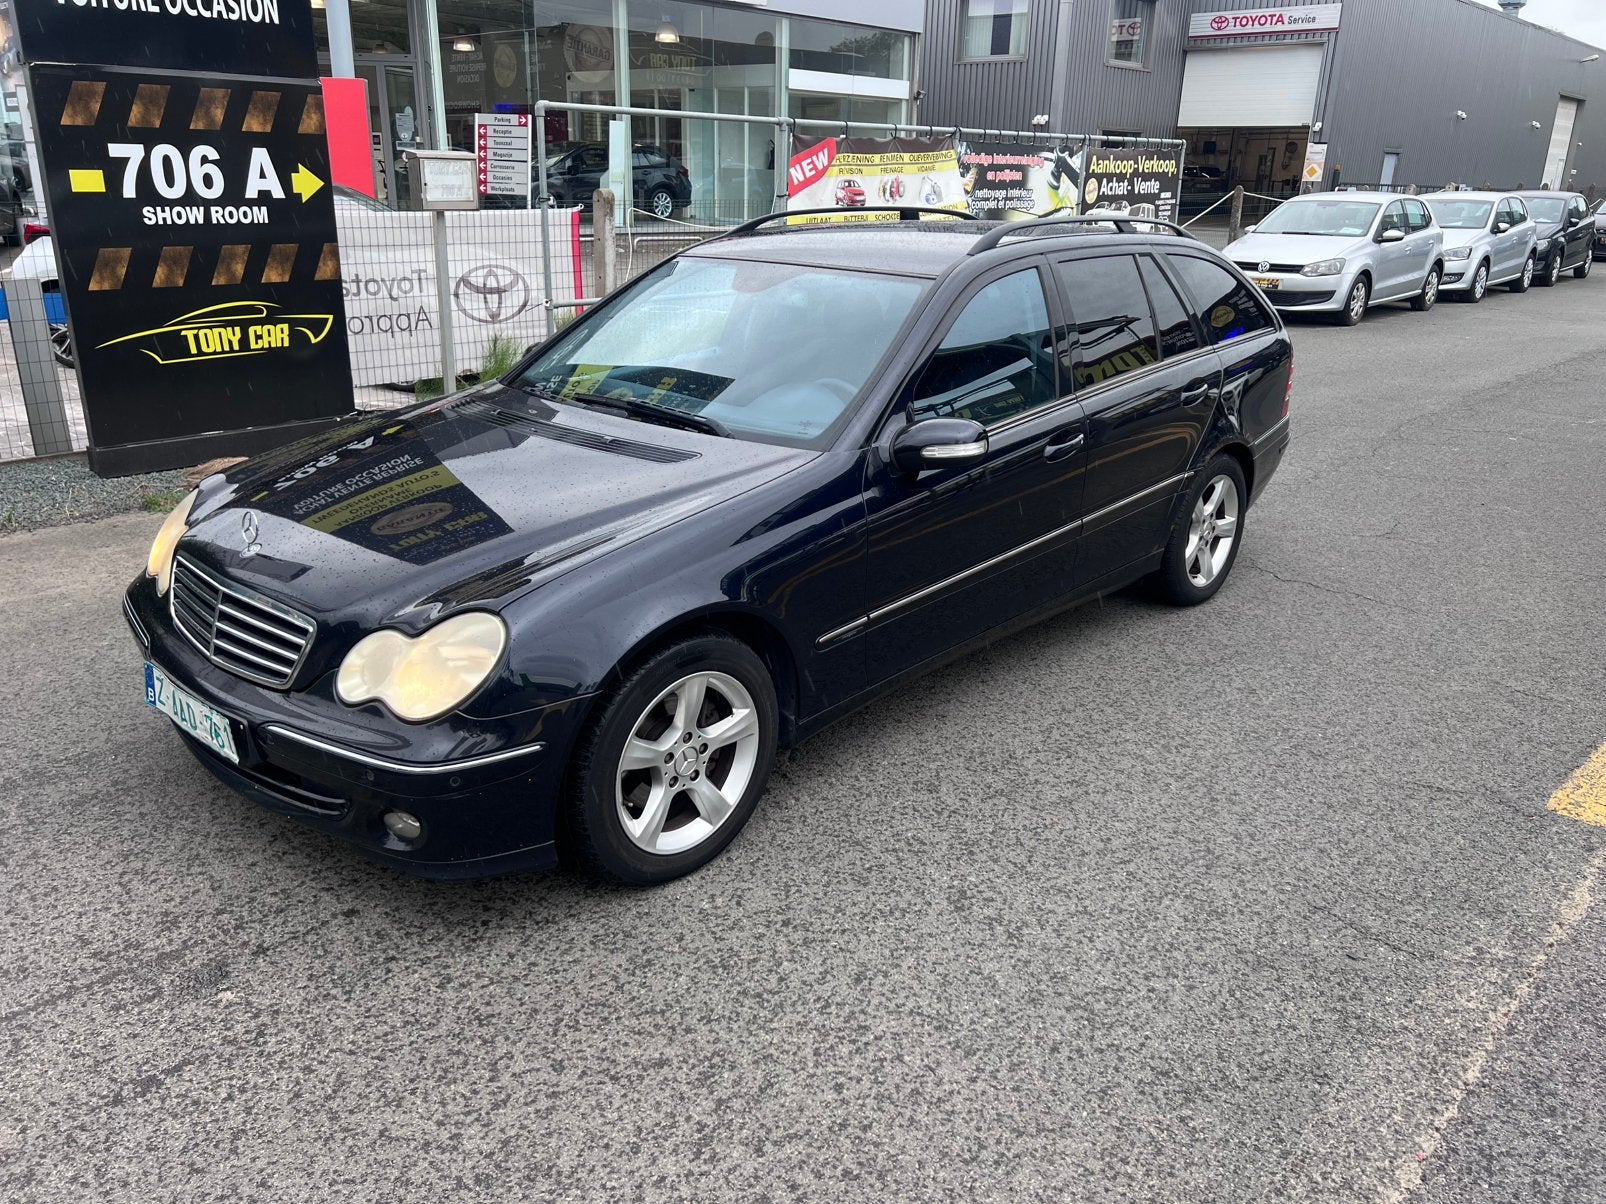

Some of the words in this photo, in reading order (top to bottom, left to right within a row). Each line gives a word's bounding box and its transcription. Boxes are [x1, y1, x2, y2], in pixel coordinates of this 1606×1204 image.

[1231, 13, 1285, 28] TOYOTA
[1287, 13, 1316, 25] Service
[494, 116, 511, 124] Parking
[107, 143, 225, 200] 706
[244, 147, 286, 199] A
[789, 148, 830, 186] NEW
[975, 188, 1007, 200] nettoyage
[1007, 187, 1034, 199] intérieur
[1133, 177, 1160, 194] Vente
[971, 199, 997, 211] complet
[998, 199, 1005, 209] et
[1005, 199, 1035, 211] polissage
[142, 205, 204, 225] SHOW
[211, 206, 269, 224] ROOM
[181, 327, 242, 354] TONY
[248, 323, 290, 350] CAR
[148, 688, 155, 701] B
